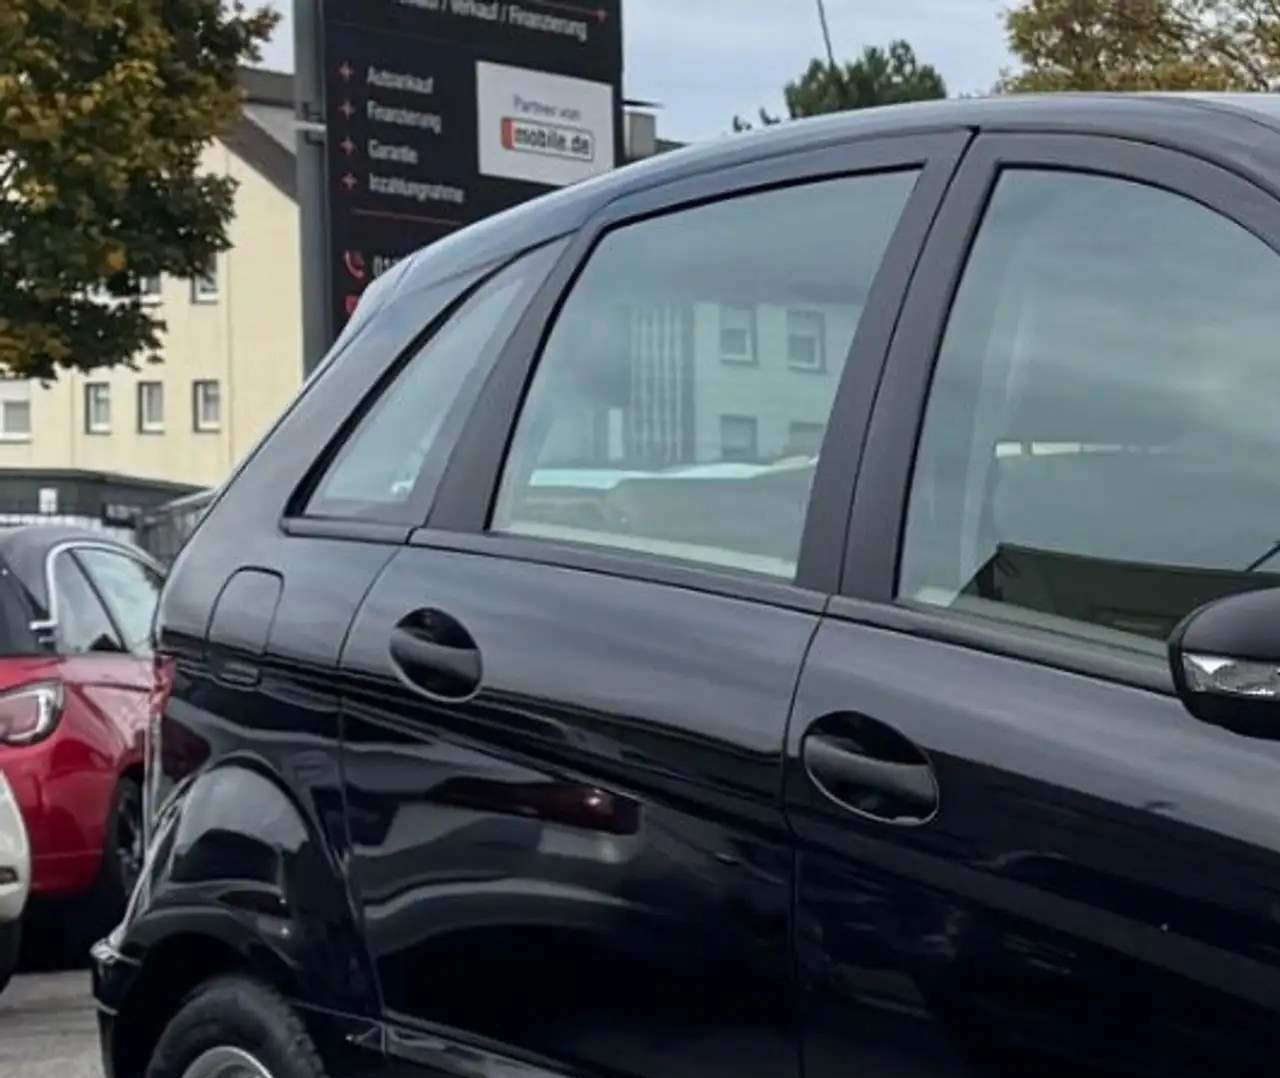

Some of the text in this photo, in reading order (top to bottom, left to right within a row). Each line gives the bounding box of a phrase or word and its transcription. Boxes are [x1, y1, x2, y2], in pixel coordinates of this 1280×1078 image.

[508, 4, 588, 42] Finanzierung
[366, 66, 434, 93] Autoankauf
[366, 100, 442, 135] Finanzierung
[512, 94, 582, 121] Partner von
[367, 138, 418, 165] Garantie
[514, 126, 590, 155] mobile.de
